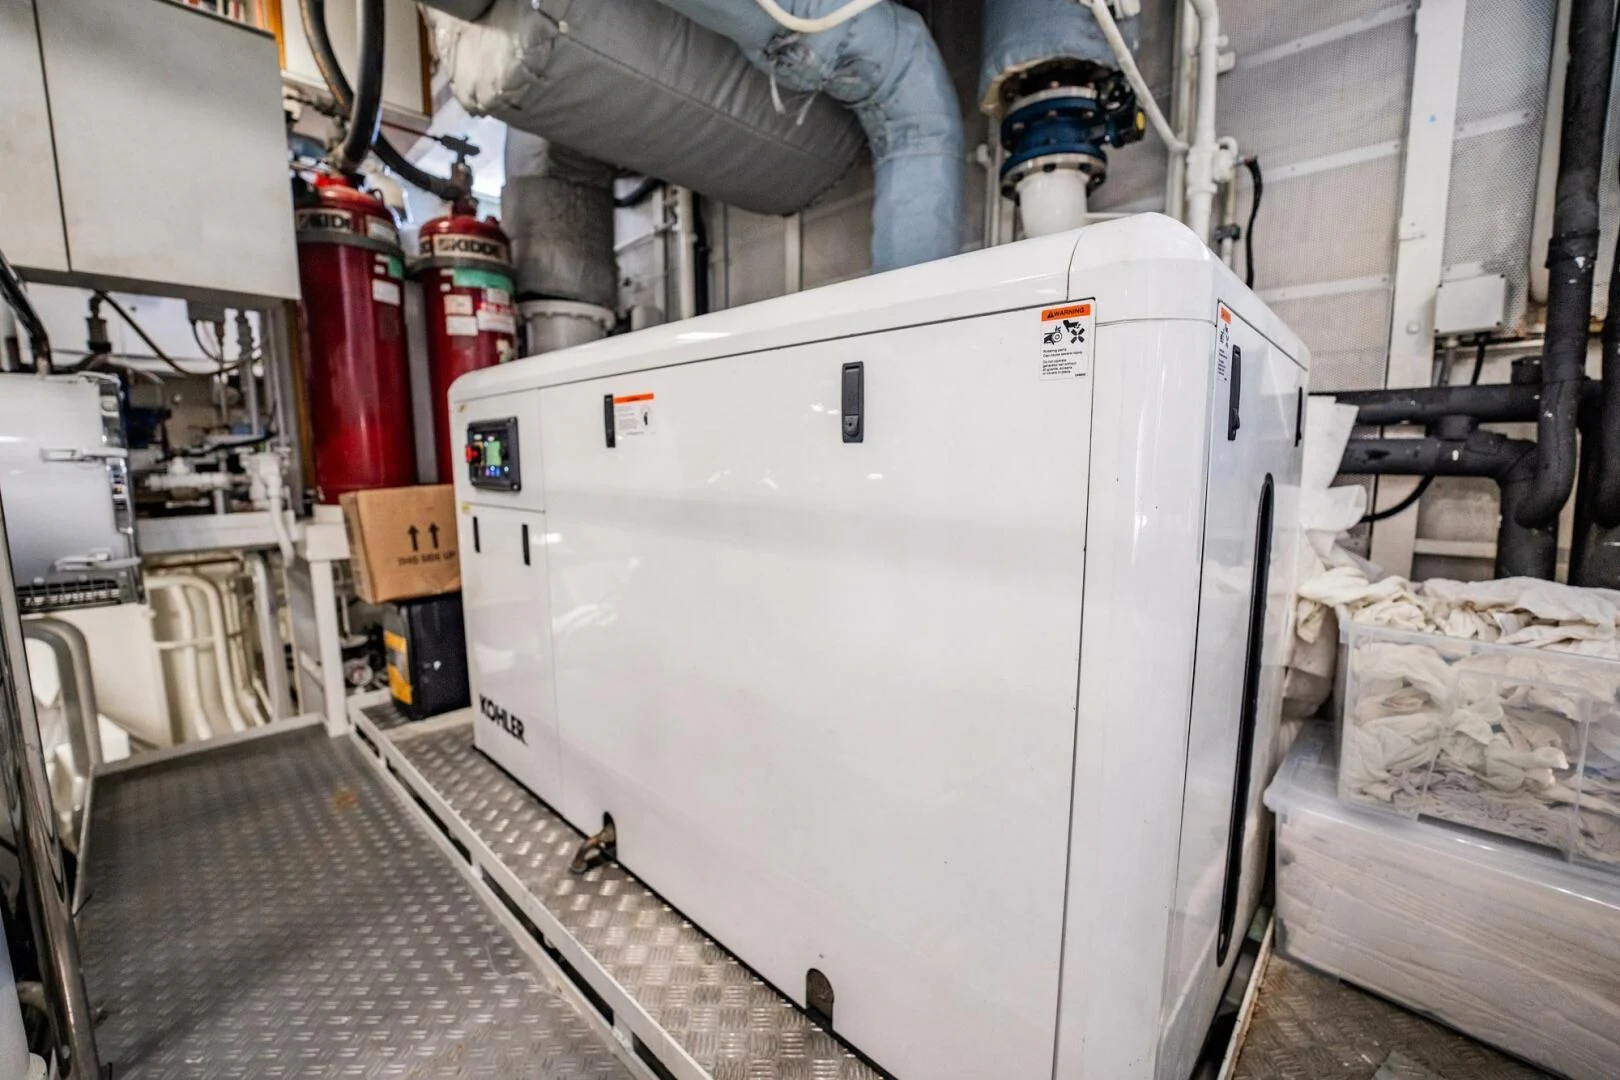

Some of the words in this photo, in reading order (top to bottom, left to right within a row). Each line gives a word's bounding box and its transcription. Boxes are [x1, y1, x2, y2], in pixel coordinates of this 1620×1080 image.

[1054, 307, 1085, 316] WARNING
[398, 556, 418, 566] THIS
[421, 553, 441, 563] SIDE
[479, 694, 528, 746] KOHLER
